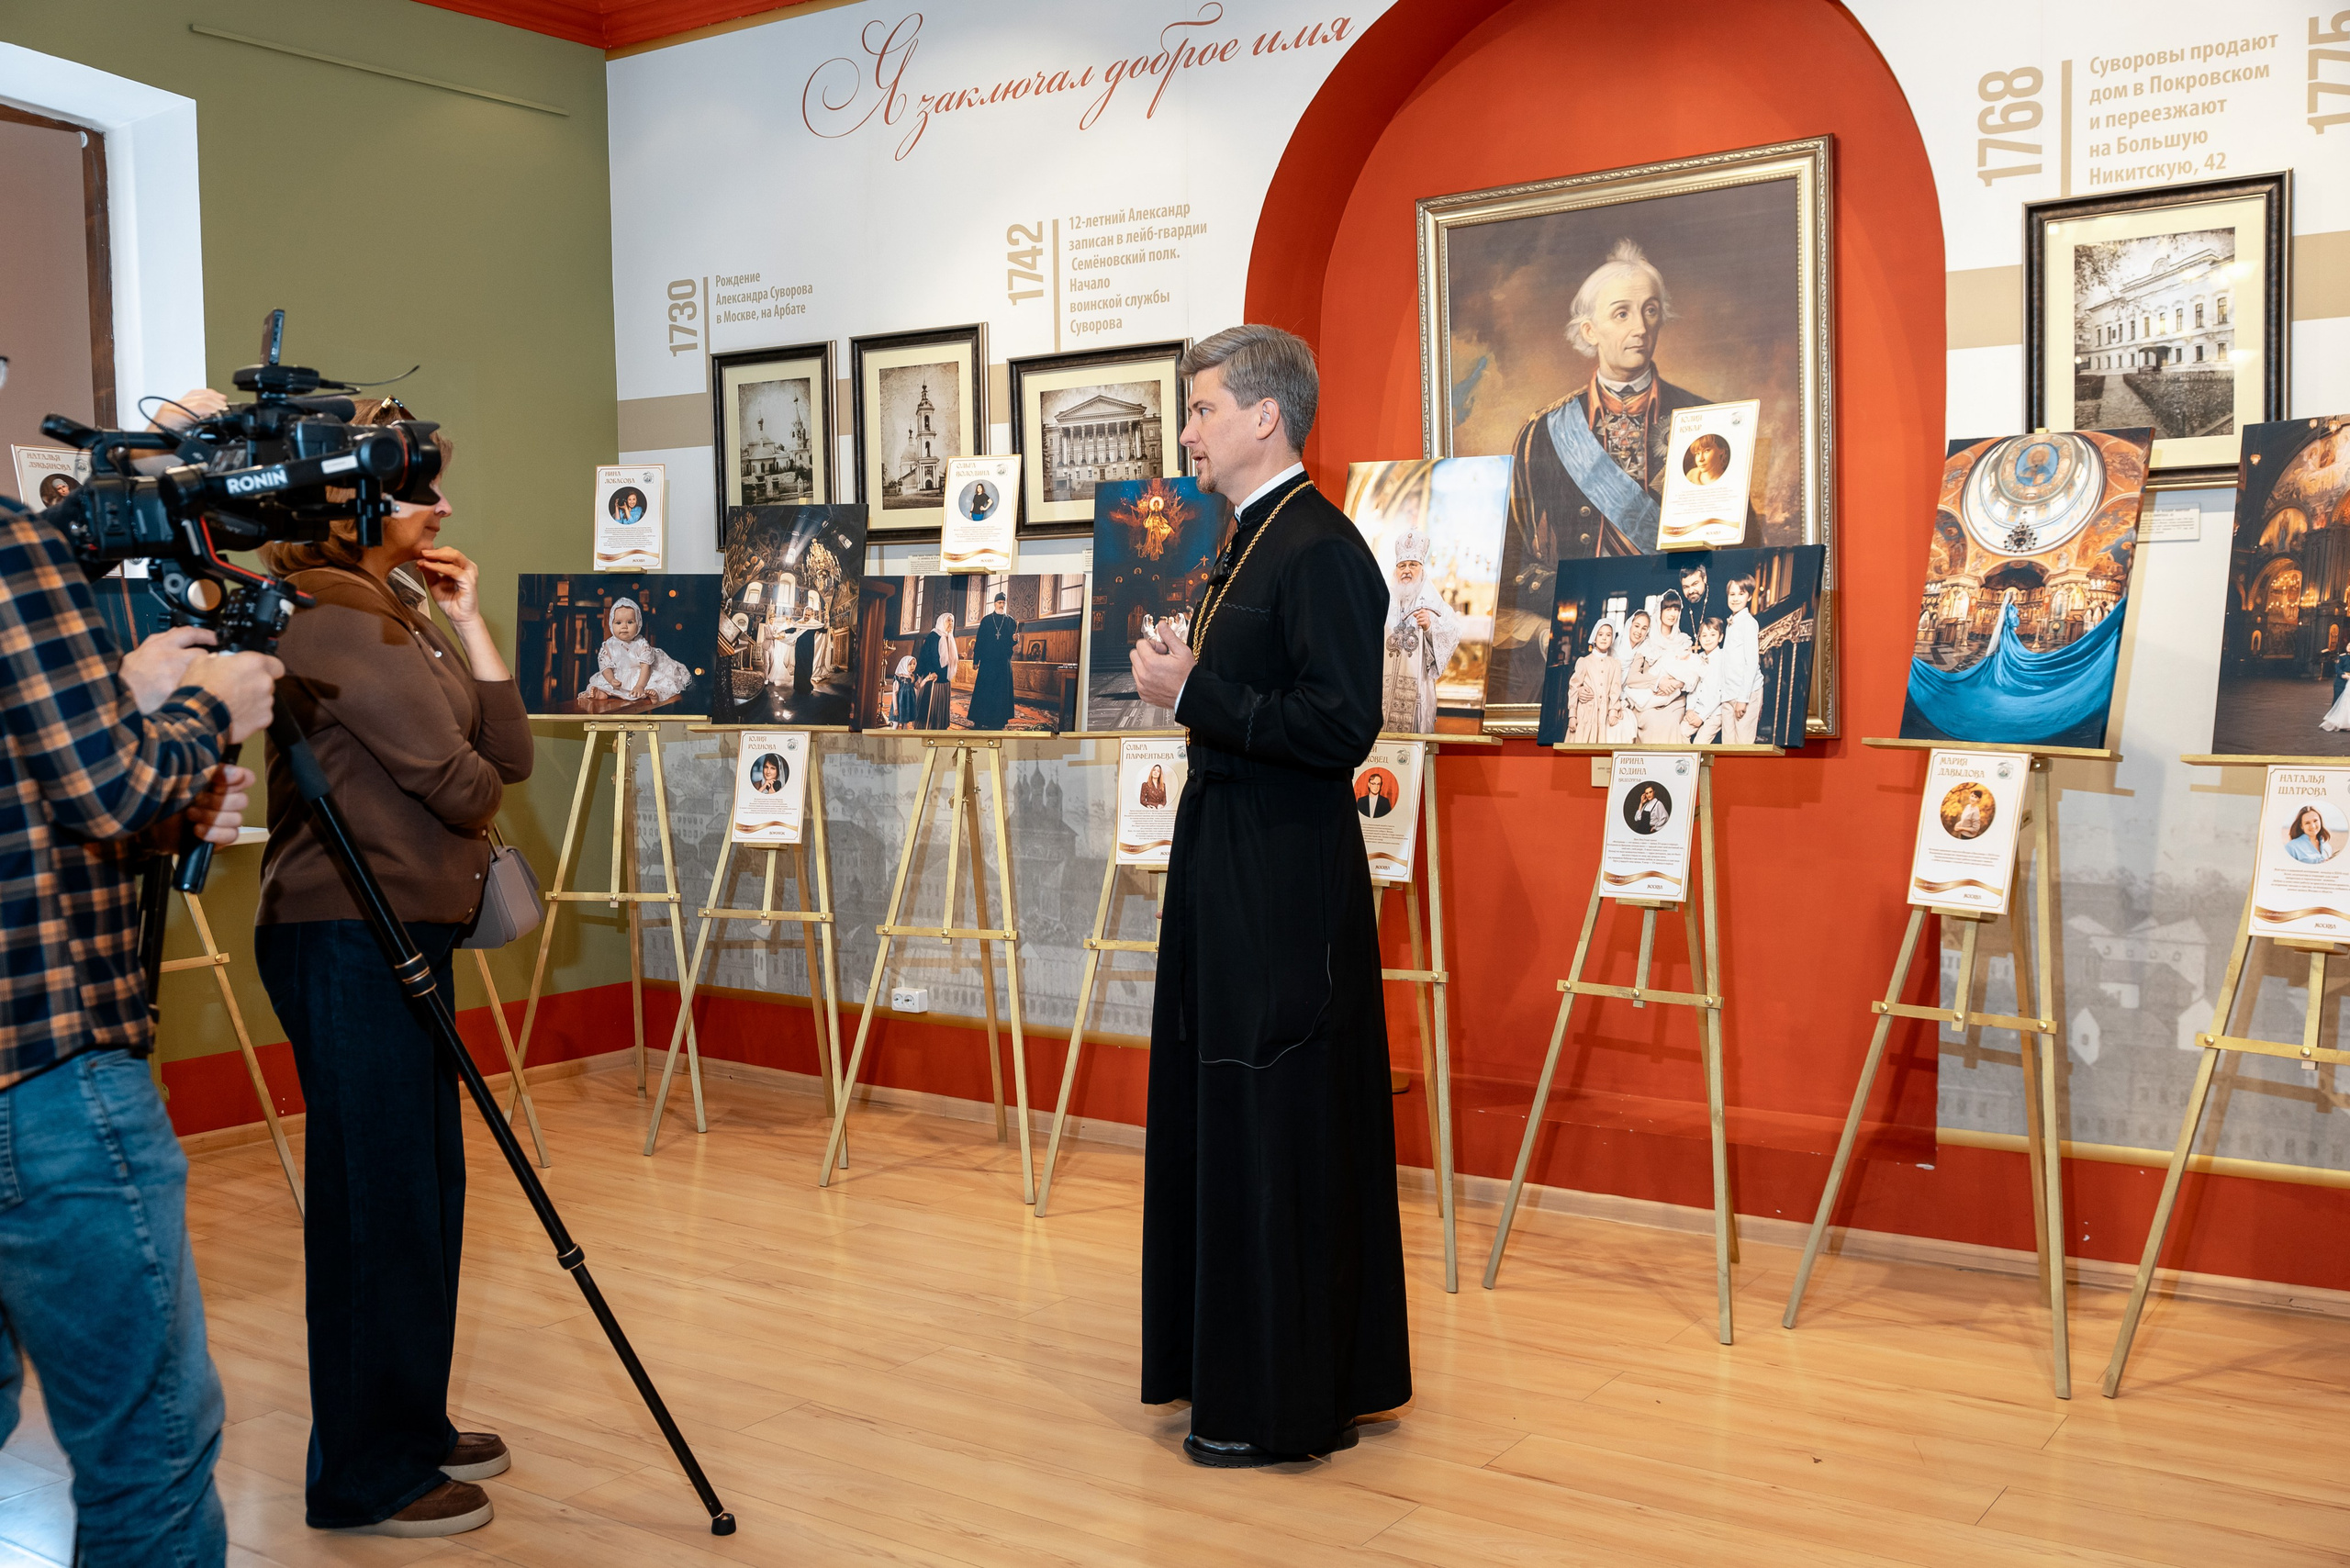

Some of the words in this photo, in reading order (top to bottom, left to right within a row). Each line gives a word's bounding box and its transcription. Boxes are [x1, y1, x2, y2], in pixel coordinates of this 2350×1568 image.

[2089, 48, 2185, 78] Суворовы
[2190, 34, 2278, 62] продают
[802, 13, 923, 139] Я
[895, 65, 1096, 162] заключал
[1080, 2, 1241, 130] доброе
[1252, 17, 1354, 57] имя
[2089, 84, 2128, 106] дом
[2133, 82, 2144, 96] в
[2150, 64, 2270, 94] Покровском
[2089, 116, 2100, 130] и
[2105, 98, 2228, 129] переезжают
[1977, 66, 2043, 187] 1768
[2089, 142, 2111, 158] на
[2117, 129, 2209, 151] Большую
[2089, 159, 2199, 185] Никитскую,
[2204, 151, 2227, 171] 42
[1069, 209, 1125, 230] 12-летний
[1128, 203, 1191, 222] Александр
[1069, 235, 1113, 251] записан
[1116, 233, 1124, 244] в
[1126, 223, 1207, 243] лейб-гвардии
[1007, 220, 1044, 306] 1742
[1071, 249, 1147, 271] Семёновский
[1148, 248, 1181, 262] полк.
[715, 272, 761, 287] Рождение
[1069, 277, 1111, 292] Начало
[715, 290, 768, 306] Александра
[770, 284, 813, 301] Суворова
[1069, 295, 1122, 313] воинской
[1125, 289, 1170, 309] службы
[667, 278, 698, 357] 1730
[716, 314, 722, 324] в
[723, 309, 759, 323] Москве,
[761, 308, 772, 319] на
[774, 303, 806, 319] Арбате
[1070, 318, 1123, 337] Суворова
[27, 453, 61, 461] НАТАЛЬЯ
[226, 469, 288, 495] RONIN
[1618, 767, 1647, 776] ЮДИНА
[1937, 767, 1986, 778] ДАВЫДОВА
[1940, 756, 1968, 766] МАРИЯ
[2279, 774, 2325, 784] НАТАЛЬЯ
[2277, 786, 2327, 797] ШАТРОВА
